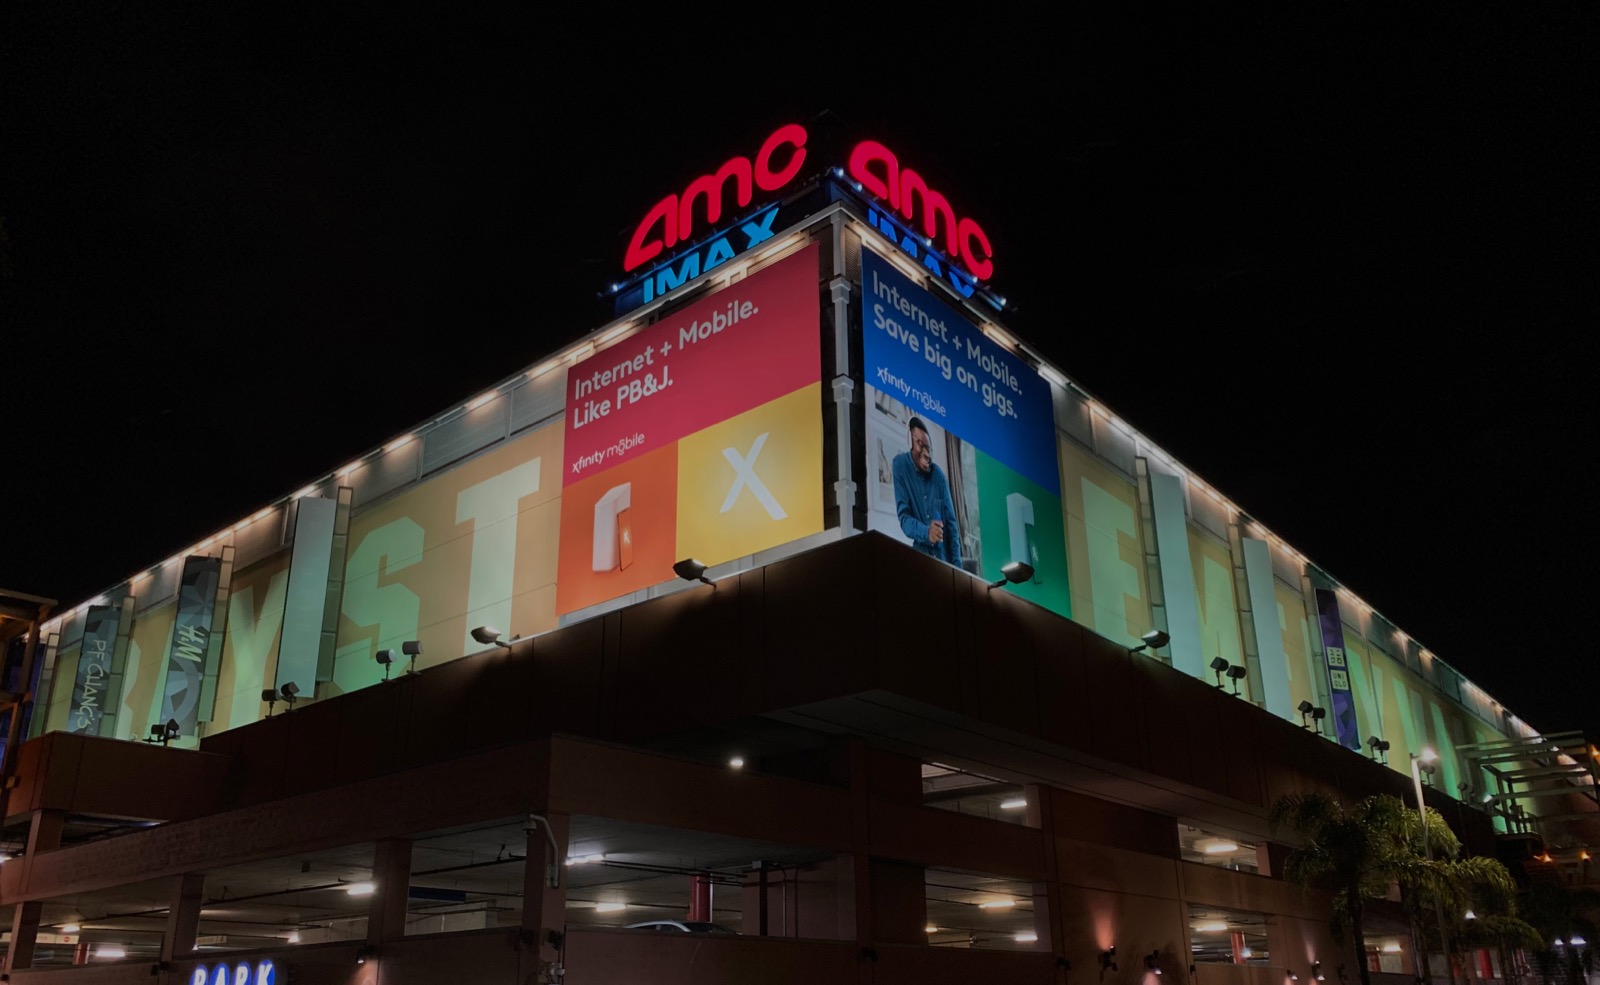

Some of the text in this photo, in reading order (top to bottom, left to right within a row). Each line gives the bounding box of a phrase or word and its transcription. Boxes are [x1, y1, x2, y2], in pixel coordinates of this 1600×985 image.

[643, 206, 780, 304] IMAX
[574, 344, 654, 401] Internet
[678, 299, 760, 351] Mobile.
[872, 270, 948, 344] Internet
[966, 337, 1023, 396] Mobile.
[873, 303, 1018, 419] Save big on gigs.
[573, 365, 674, 430] Like PB&J.
[877, 366, 911, 396] xfinity
[571, 447, 606, 474] xfinity
[174, 624, 206, 663] H&M
